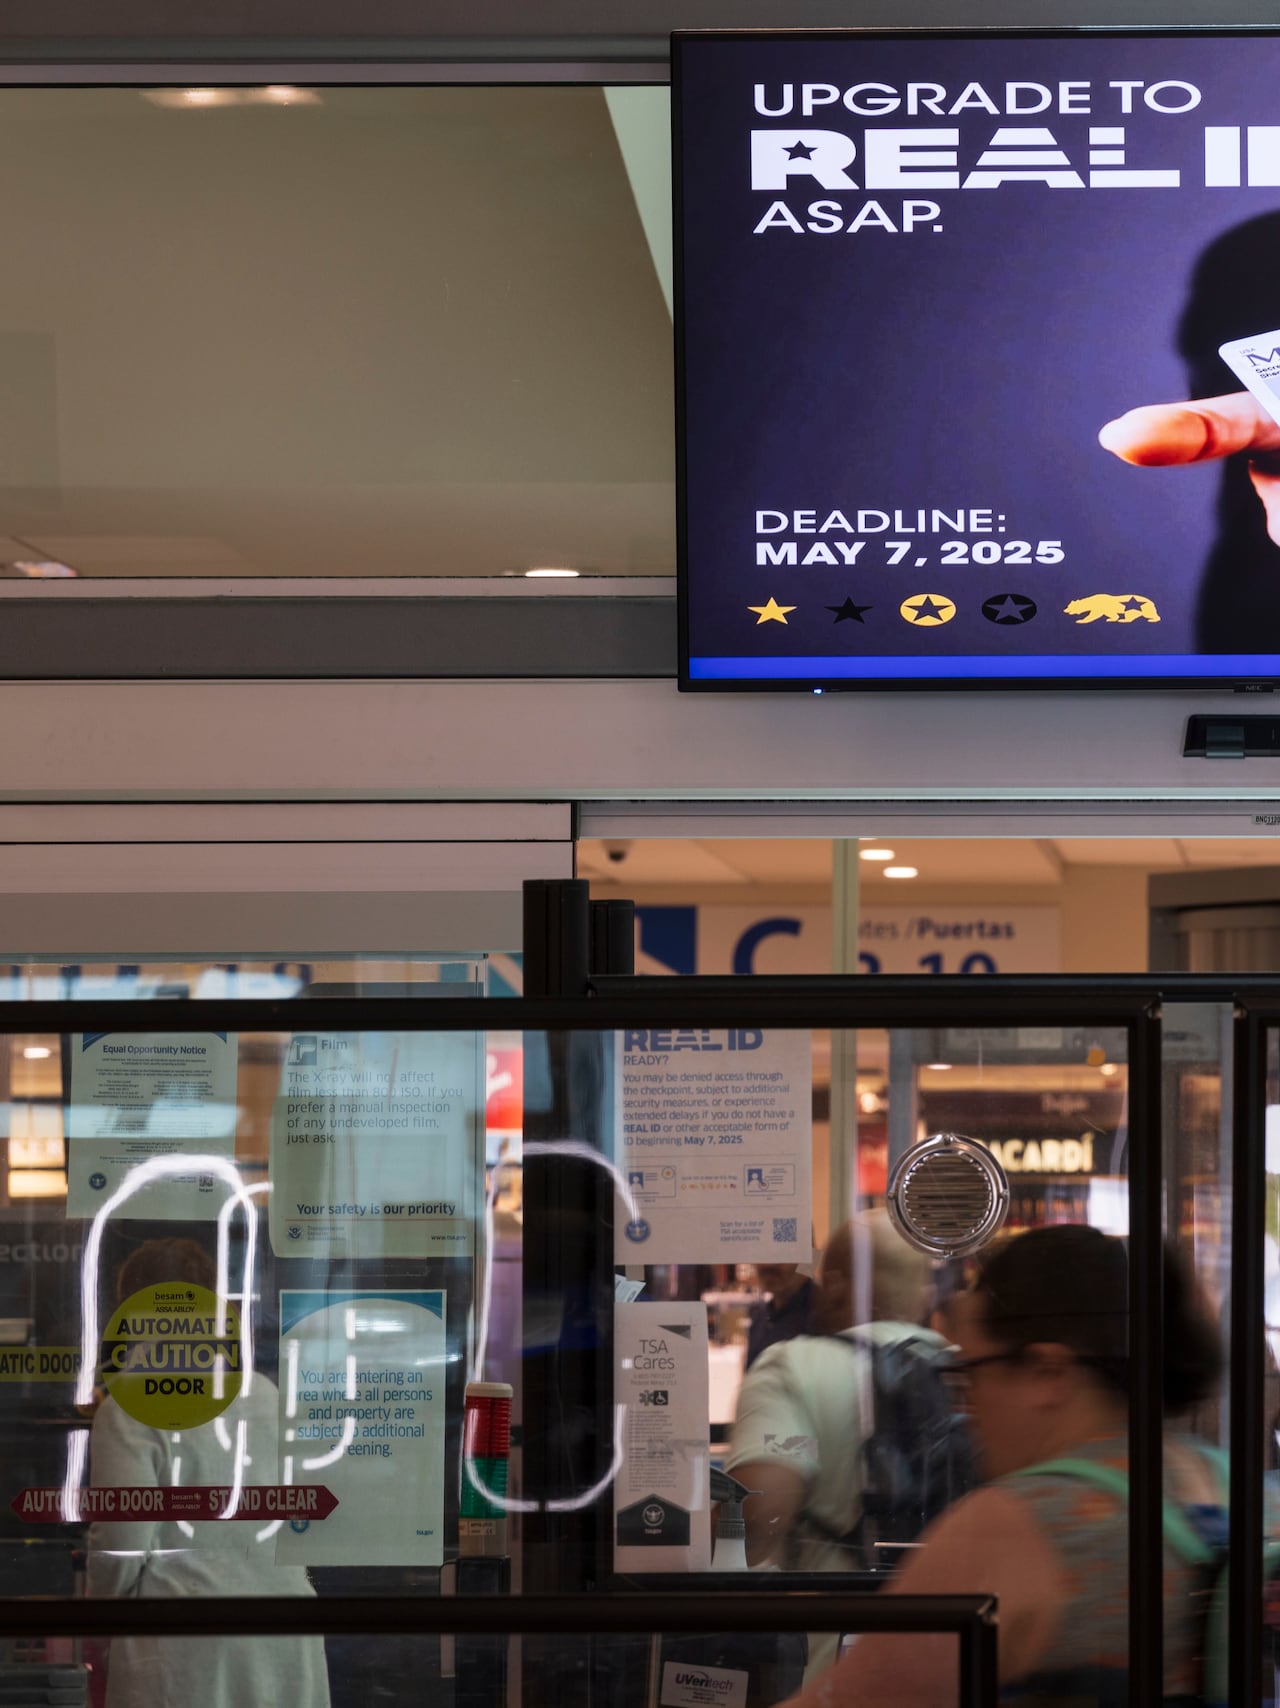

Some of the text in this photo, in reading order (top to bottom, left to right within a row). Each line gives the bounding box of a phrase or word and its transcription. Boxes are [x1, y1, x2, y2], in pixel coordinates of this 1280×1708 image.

[753, 79, 1202, 116] UPGRADE TO
[750, 126, 1180, 190] REAL
[753, 200, 944, 234] ASAP.
[756, 508, 1006, 534] DEADLINE:
[756, 540, 1065, 567] MAY 7, 2025
[321, 1039, 348, 1051] Film
[624, 1028, 763, 1052] REAL ID
[103, 1044, 207, 1056] Equal Opportunity Notice
[624, 1055, 669, 1066] READY?
[287, 1071, 435, 1085] The X-ray will affect
[624, 1072, 783, 1084] You may be denied access through
[287, 1087, 311, 1098] film
[315, 1087, 338, 1098] less
[342, 1087, 369, 1098] than
[401, 1087, 424, 1098] ISO.
[427, 1087, 437, 1098] If
[440, 1088, 463, 1100] you
[624, 1085, 639, 1095] the
[640, 1084, 692, 1096] checkpoint,
[695, 1084, 729, 1095] subject
[743, 1083, 789, 1093] additional
[287, 1101, 451, 1115] prefer a manual inspection
[287, 1116, 440, 1130] of any undeveloped film,
[624, 1121, 790, 1133] REAL ID or other acceptable form of
[286, 1132, 336, 1144] just ask.
[635, 1135, 682, 1146] beginning
[684, 1136, 704, 1146] May
[296, 1203, 456, 1216] Your safety is our priority
[155, 1291, 185, 1301] besam
[116, 1317, 234, 1335] AUTOMATC
[639, 1339, 669, 1354] TSA
[111, 1343, 239, 1369] CAUTION
[633, 1355, 675, 1370] Cares
[301, 1369, 423, 1385] You are entering an
[144, 1378, 205, 1395] DOOR
[365, 1387, 433, 1402] all persons
[308, 1406, 415, 1421] and property are
[297, 1423, 424, 1440] subject additional
[120, 1490, 165, 1512] DOOR
[208, 1489, 318, 1511] STND CLEAR
